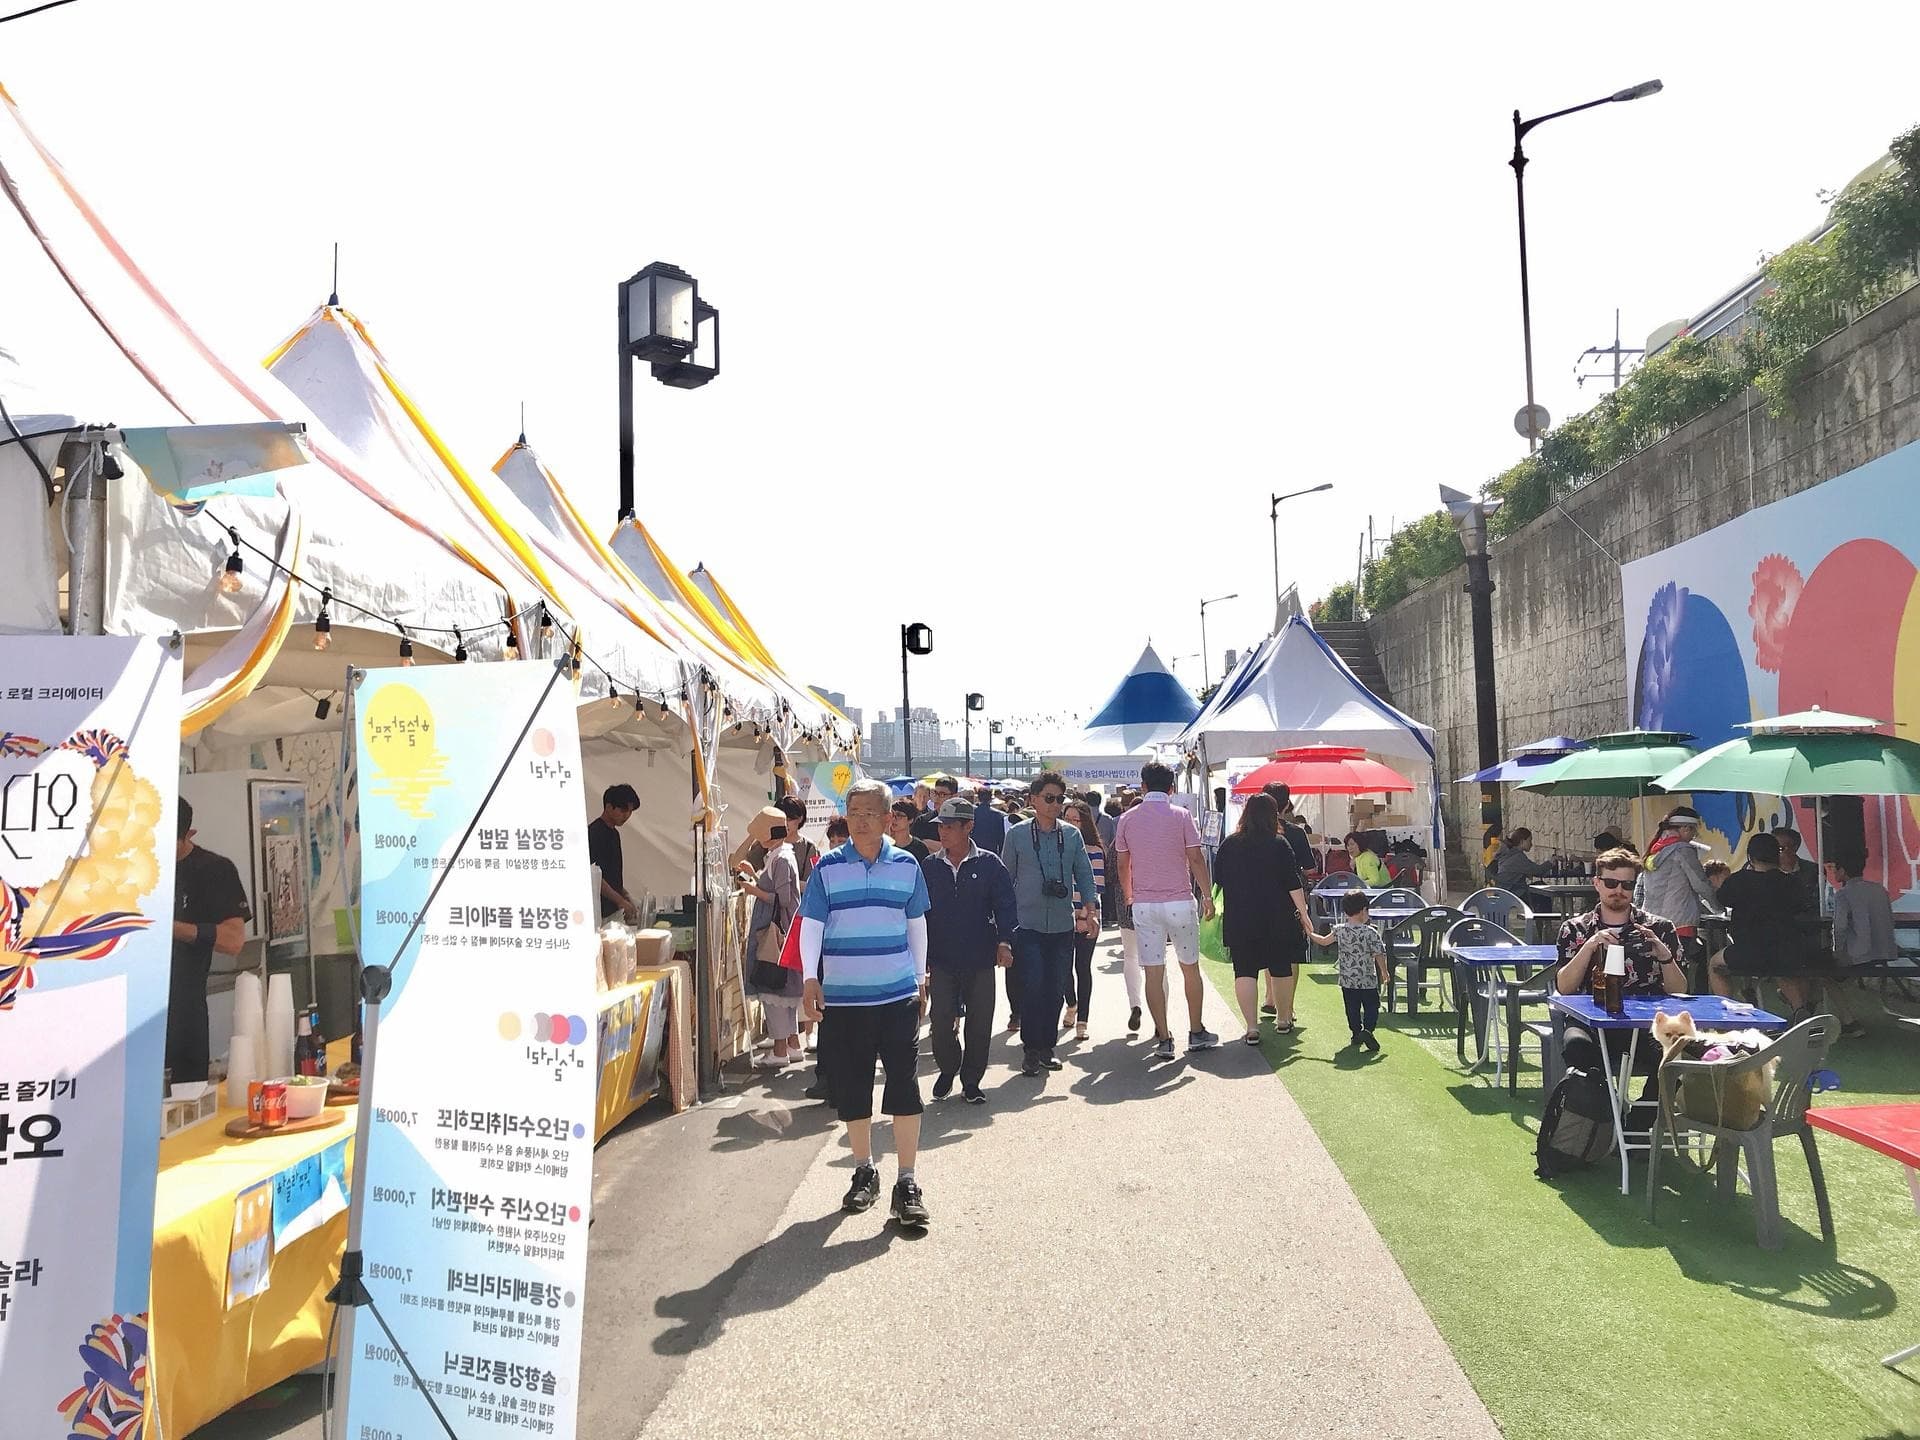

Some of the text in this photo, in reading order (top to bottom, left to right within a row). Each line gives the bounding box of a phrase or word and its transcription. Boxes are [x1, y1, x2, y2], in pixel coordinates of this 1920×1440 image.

[7, 687, 103, 700] 로컬 크리에이터
[16, 1078, 77, 1102] 즐기기
